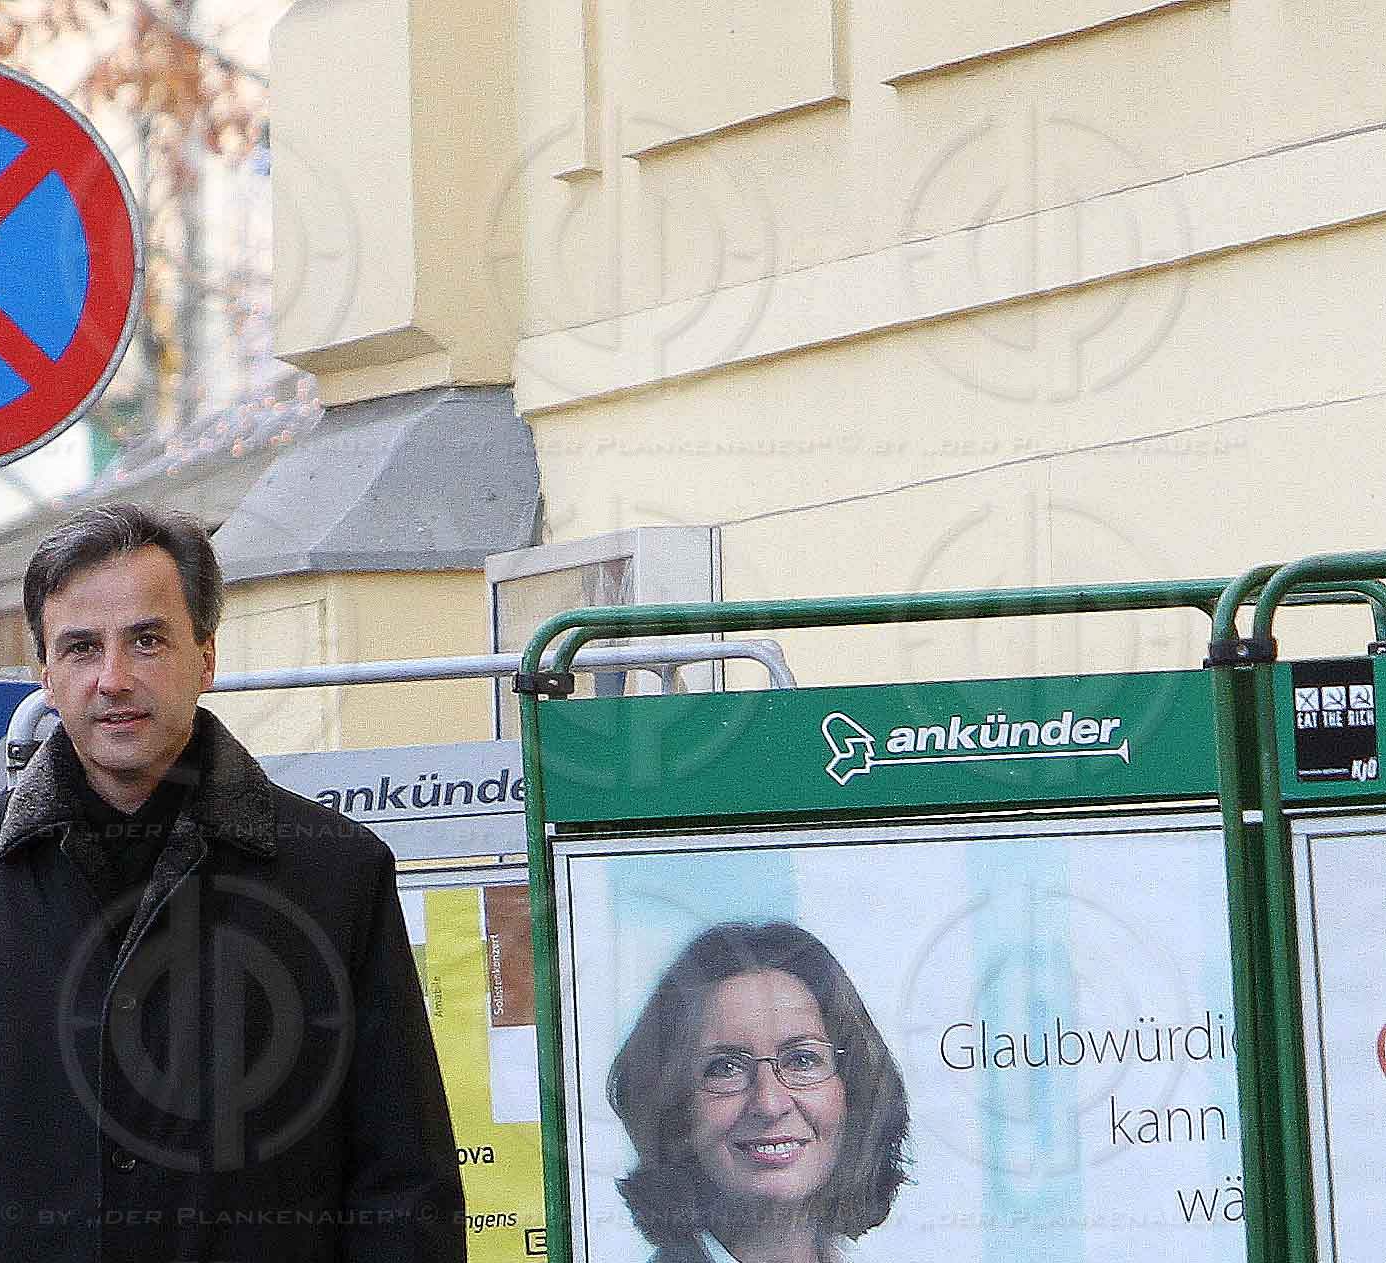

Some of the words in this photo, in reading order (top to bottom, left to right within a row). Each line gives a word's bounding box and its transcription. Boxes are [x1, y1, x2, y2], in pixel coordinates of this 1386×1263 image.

[885, 710, 1121, 754] ankünder
[939, 1010, 1238, 1070] Glaubwürdi
[1110, 1095, 1227, 1146] kann
[1176, 1175, 1246, 1223] wä
